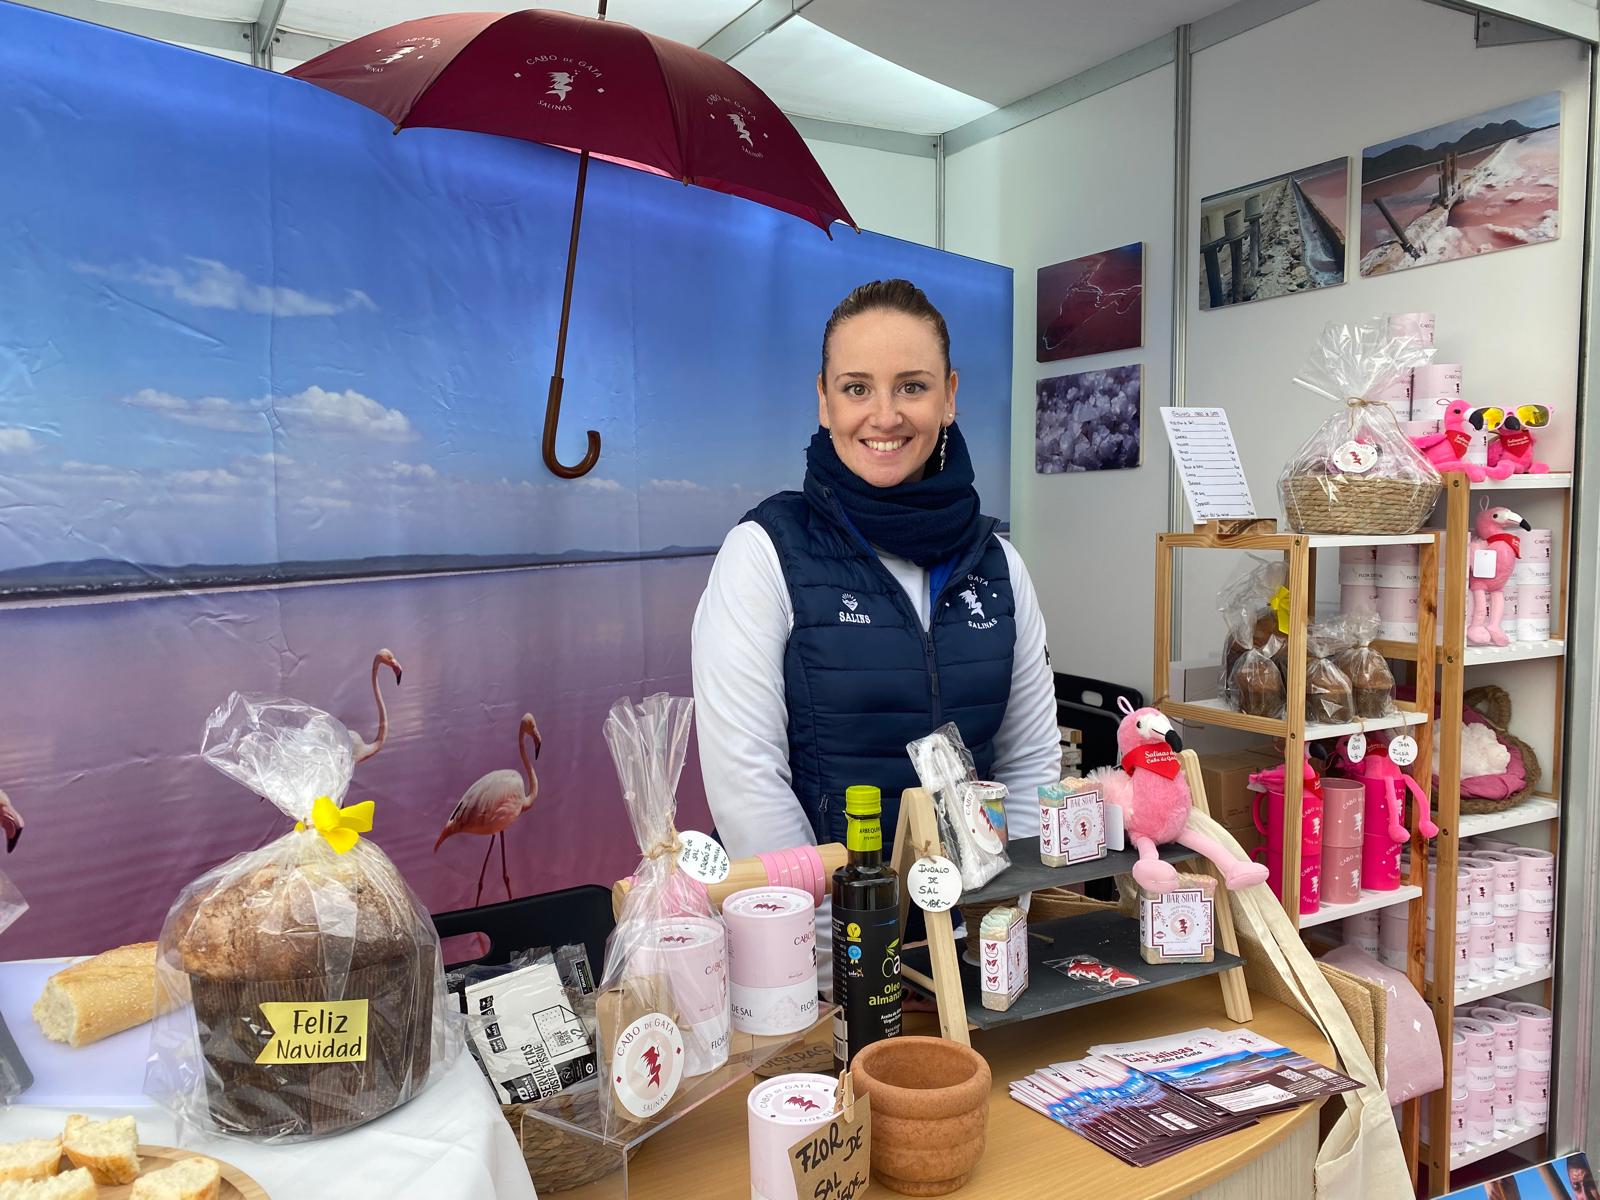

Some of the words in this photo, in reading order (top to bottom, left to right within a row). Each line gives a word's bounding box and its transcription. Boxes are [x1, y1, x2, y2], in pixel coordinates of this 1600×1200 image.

[526, 54, 558, 65] CABO
[578, 61, 603, 78] GATA
[537, 100, 573, 111] SALINAS
[967, 574, 989, 587] GATA
[839, 611, 871, 624] SALINS
[967, 618, 998, 629] SALINAS
[1145, 750, 1169, 759] Salinas
[917, 863, 950, 873] INDALO
[918, 885, 939, 894] SAL
[1166, 893, 1180, 904] BAR
[1181, 893, 1199, 904] SOAP
[793, 932, 811, 946] CABO
[704, 960, 723, 976] CABO
[731, 1003, 739, 1014] DE
[740, 1007, 753, 1018] SAL
[800, 999, 813, 1013] FLOR
[293, 1009, 348, 1035] Feliz
[617, 1026, 641, 1057] CABO
[644, 1021, 653, 1030] DE
[654, 1017, 674, 1036] GATA
[276, 1036, 362, 1060] Navidad
[1146, 1046, 1194, 1060] Salinas
[533, 1043, 551, 1069] TISSUE
[761, 1045, 832, 1070] ULSERAS
[520, 1044, 553, 1098] SERVILLETAS
[544, 1066, 560, 1096] POSTRE
[795, 1122, 844, 1174] FLOR
[843, 1124, 864, 1162] DE
[813, 1171, 842, 1200] SAL
